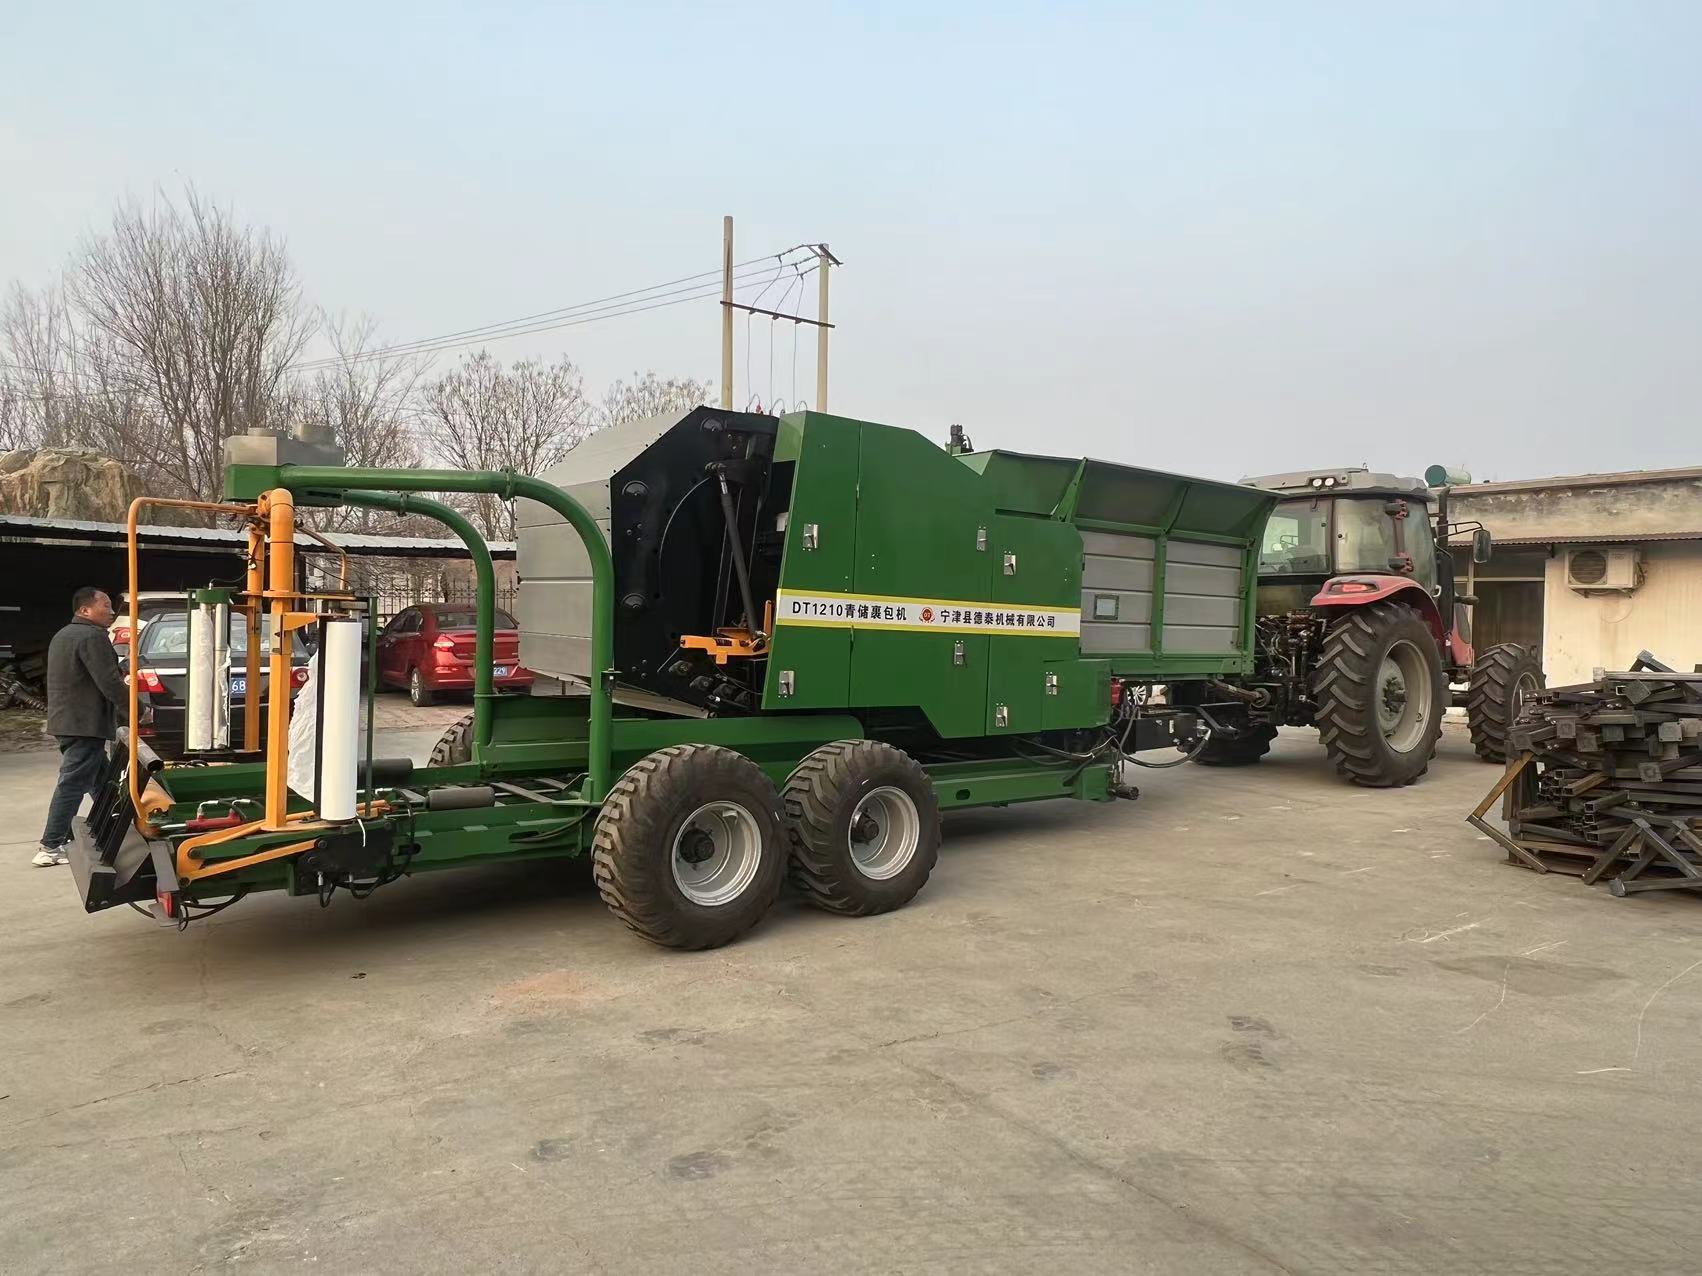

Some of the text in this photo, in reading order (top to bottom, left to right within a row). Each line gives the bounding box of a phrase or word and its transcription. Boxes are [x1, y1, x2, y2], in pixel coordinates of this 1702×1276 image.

[940, 609, 1055, 628] 宁津县德泰机械有限公司
